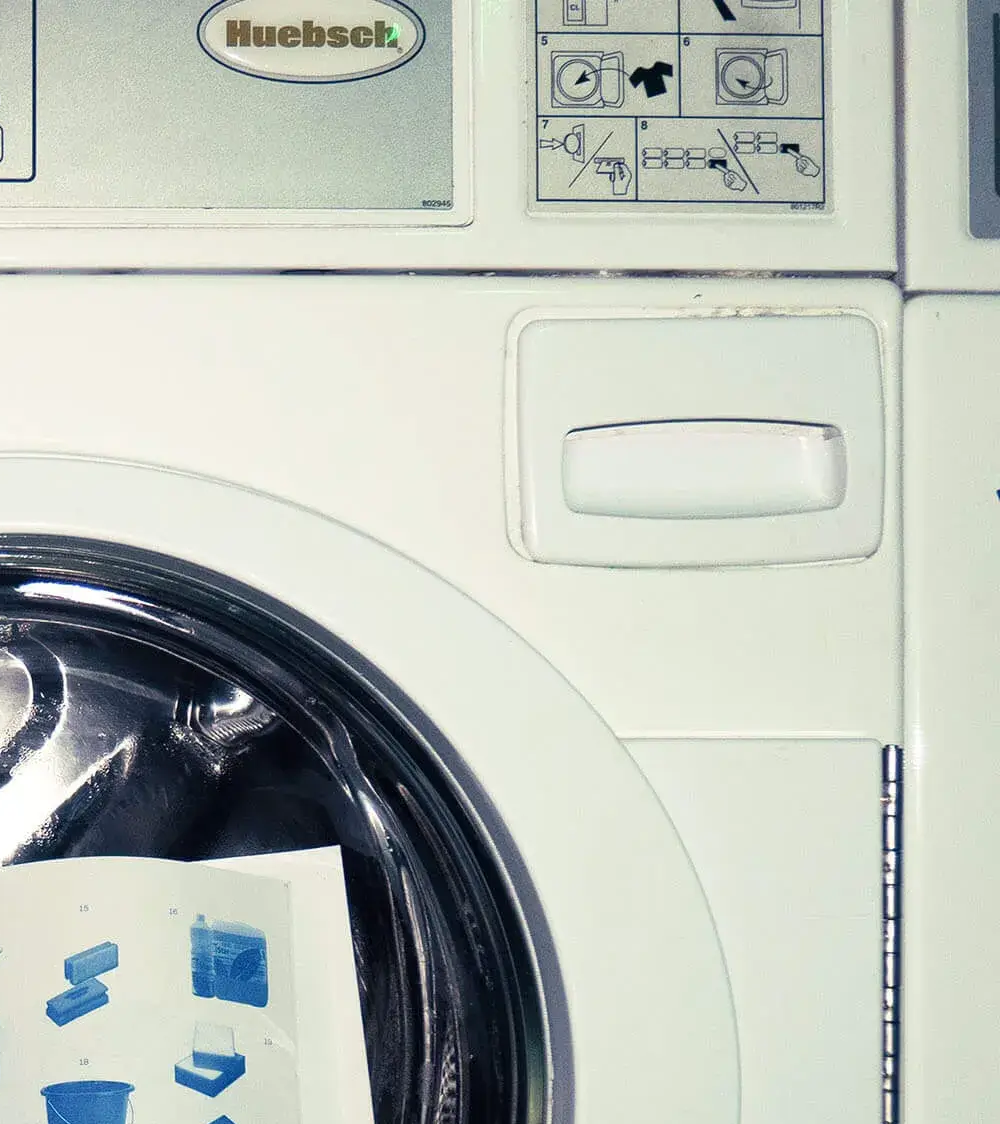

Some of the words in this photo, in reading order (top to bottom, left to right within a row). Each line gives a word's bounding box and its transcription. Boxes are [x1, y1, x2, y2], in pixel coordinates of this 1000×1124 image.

[226, 20, 399, 49] Huebsch
[541, 36, 548, 47] 5
[683, 37, 690, 47] 6
[542, 119, 549, 130] 7
[641, 120, 648, 131] 8
